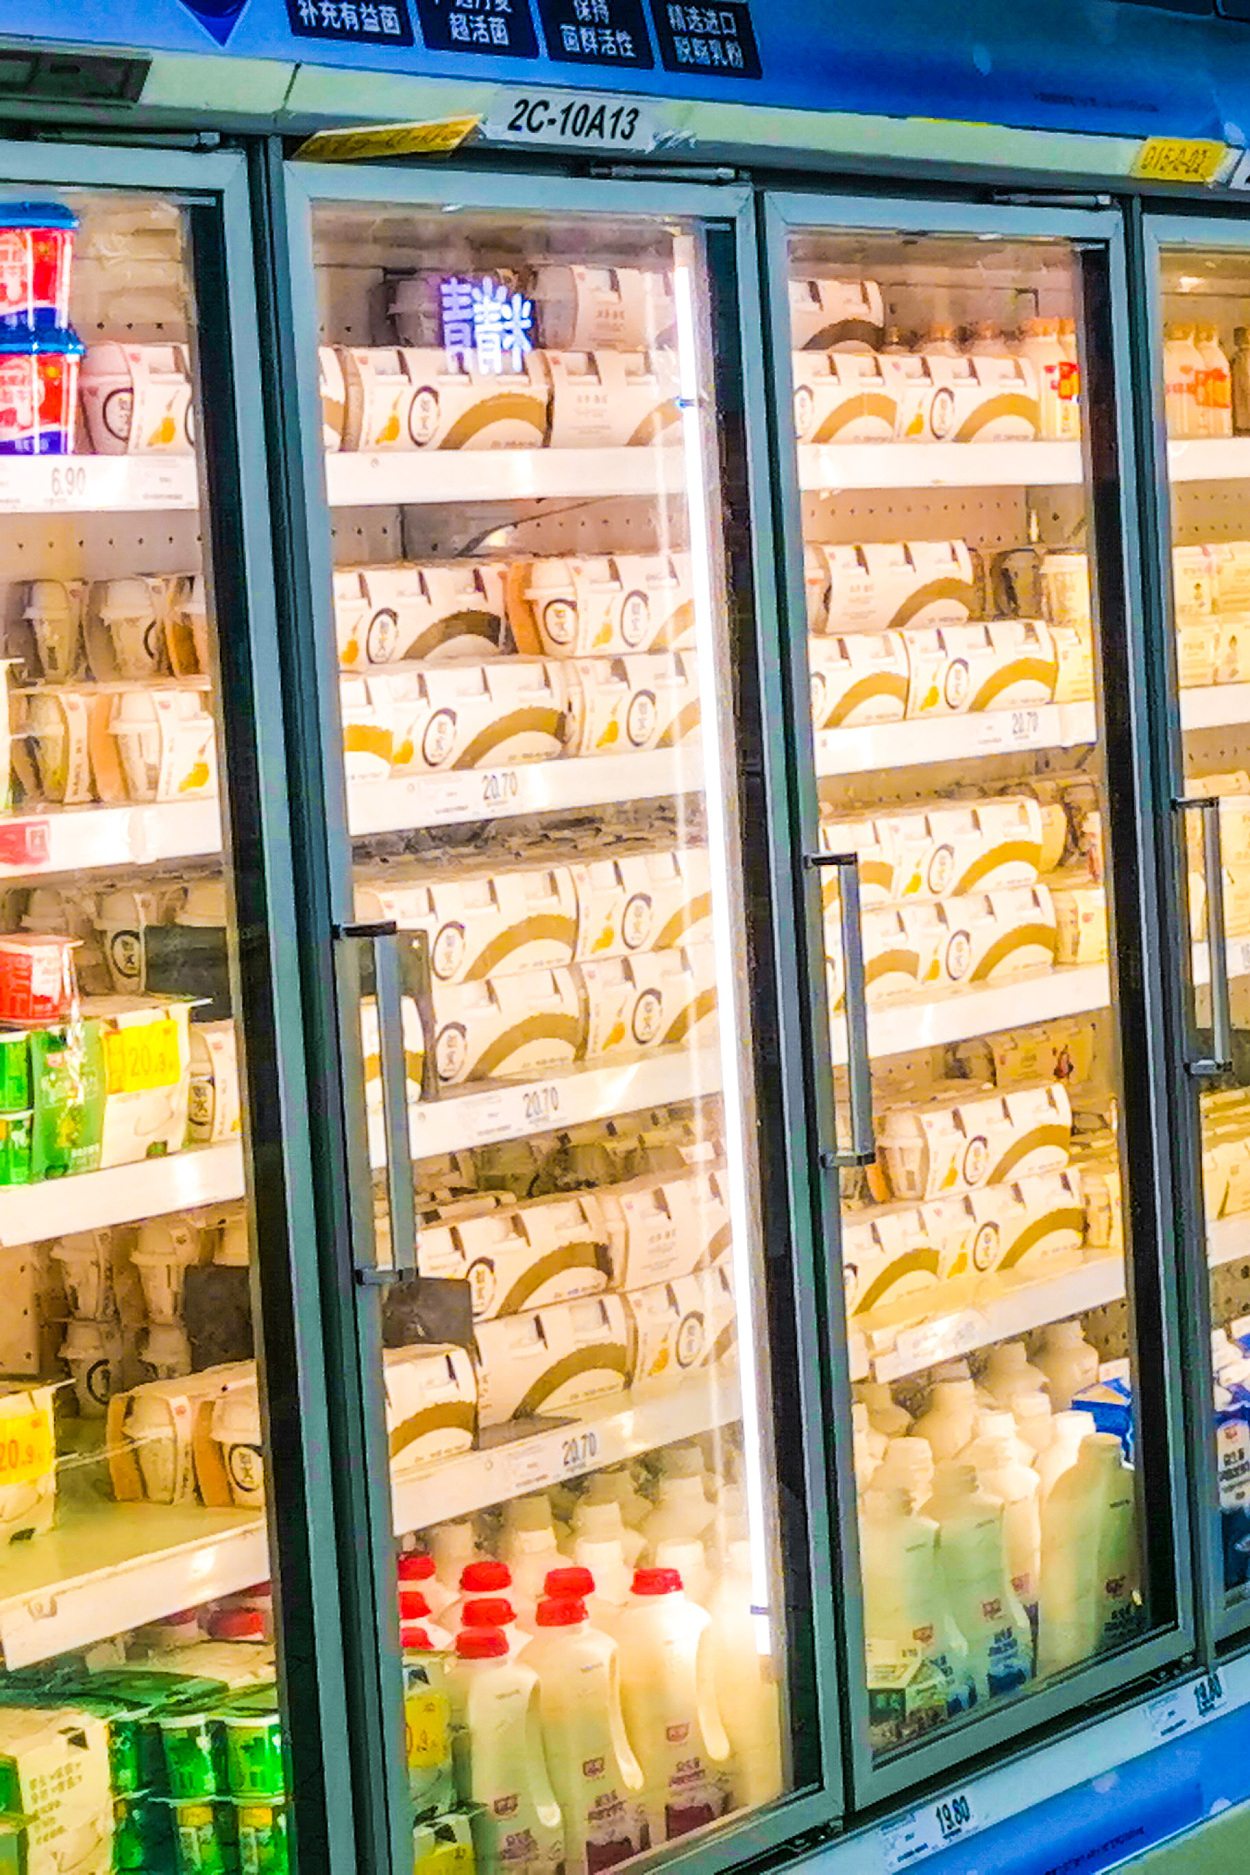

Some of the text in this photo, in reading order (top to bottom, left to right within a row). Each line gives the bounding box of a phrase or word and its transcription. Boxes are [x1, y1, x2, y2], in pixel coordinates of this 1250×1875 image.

[298, 1, 401, 35] 补充有益菌
[507, 98, 640, 140] 2C-10A13
[51, 467, 86, 496] 6.90
[481, 771, 519, 800] 20.70
[523, 1086, 559, 1118] 20.70
[562, 1432, 598, 1466] 20.70
[936, 1796, 970, 1834] 19.80
